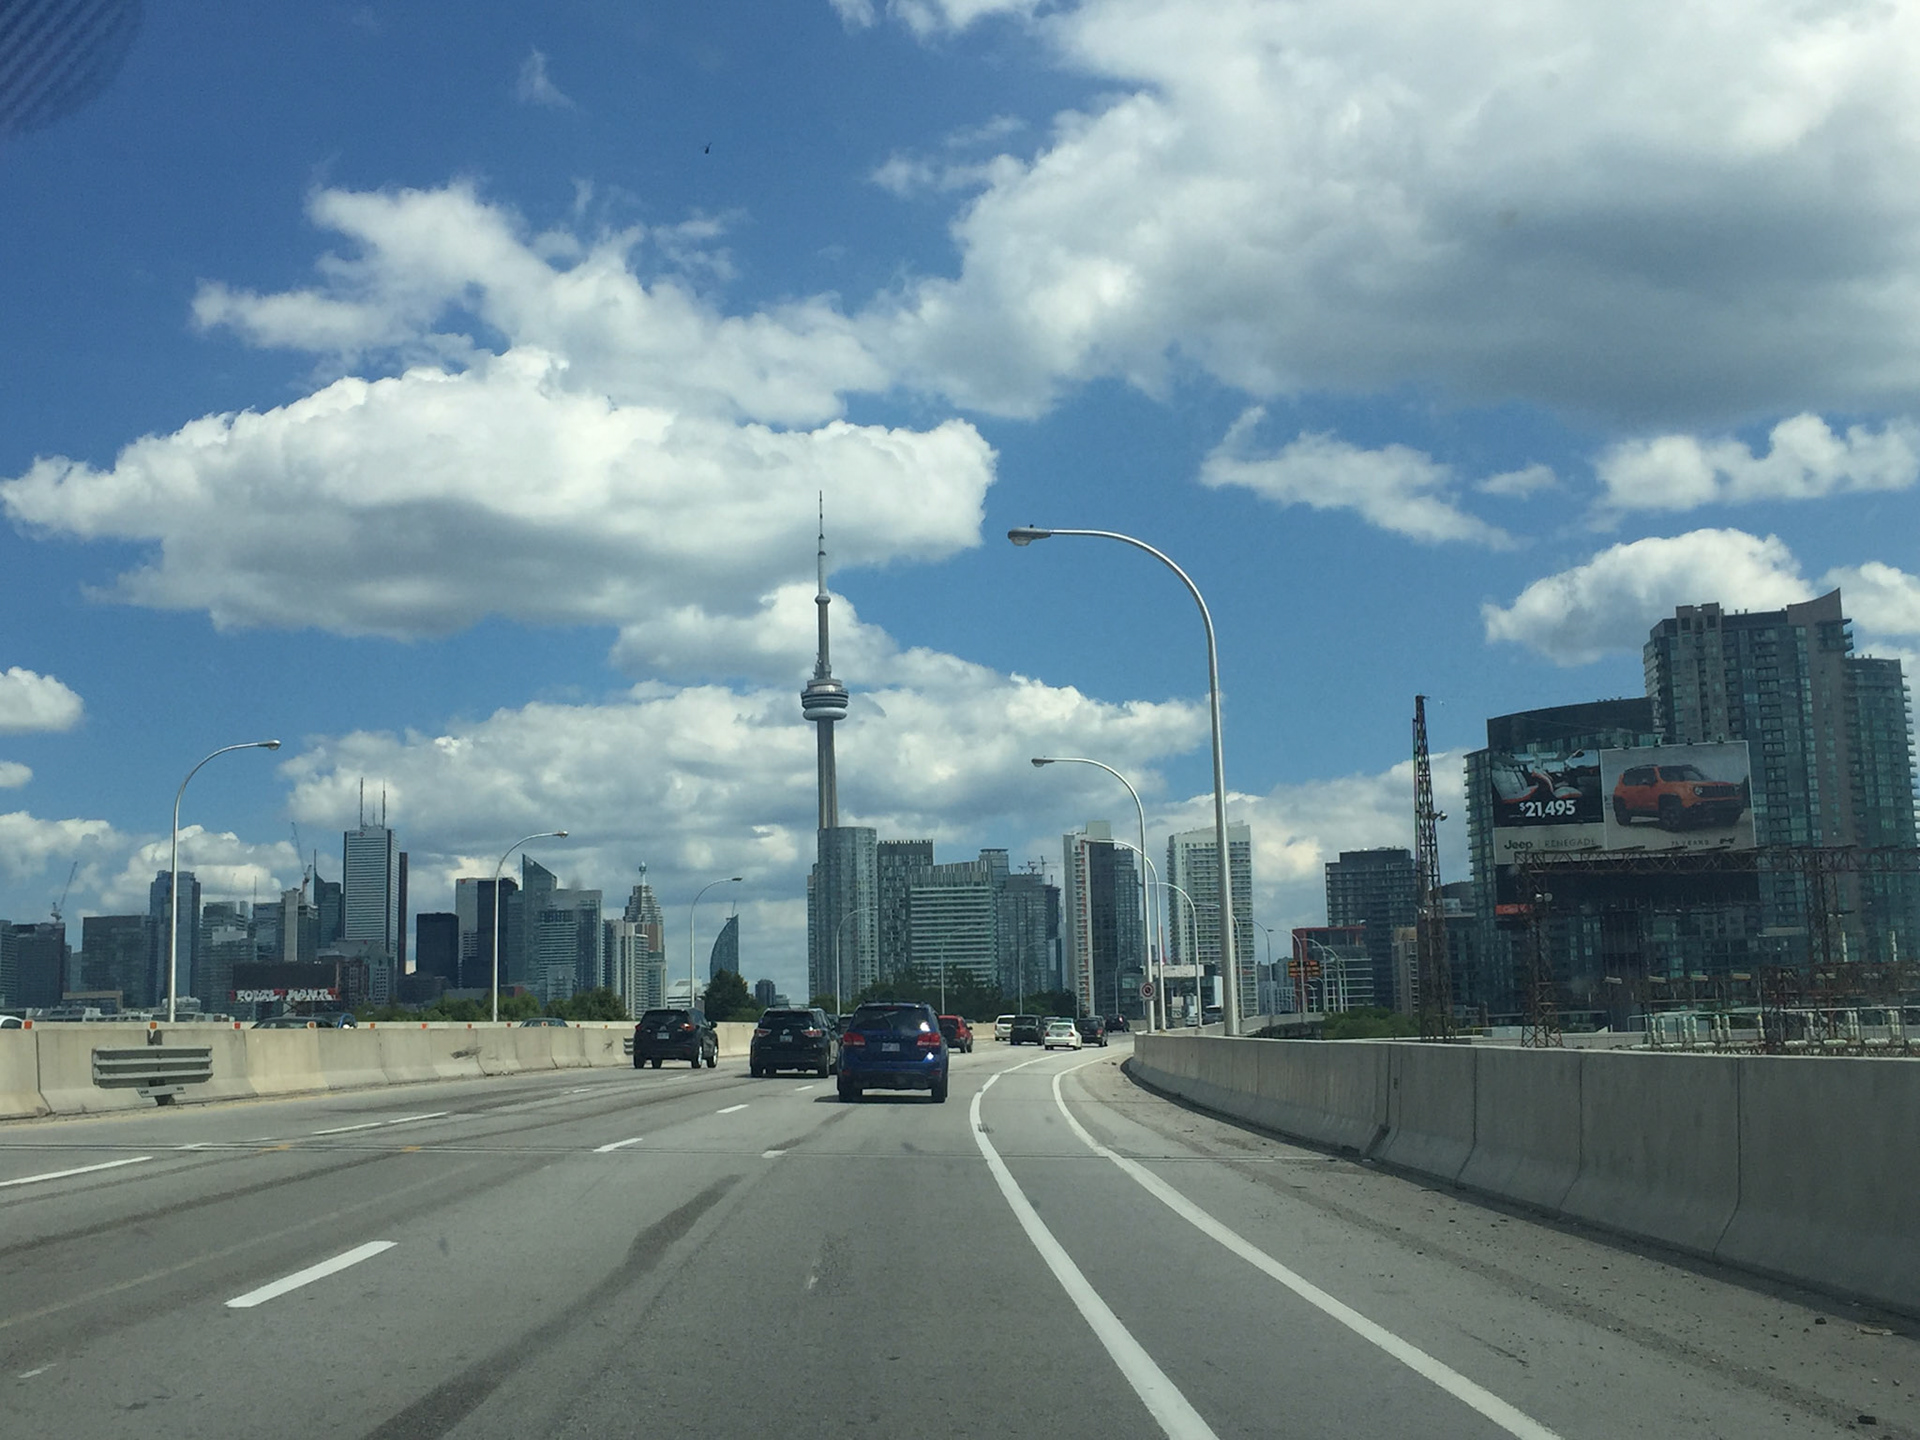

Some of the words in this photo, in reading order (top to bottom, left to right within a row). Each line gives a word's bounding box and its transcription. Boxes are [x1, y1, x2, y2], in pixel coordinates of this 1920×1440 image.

[1519, 800, 1576, 818] $21,495
[1504, 839, 1533, 850] Jeep
[1544, 838, 1596, 848] RENEGADE
